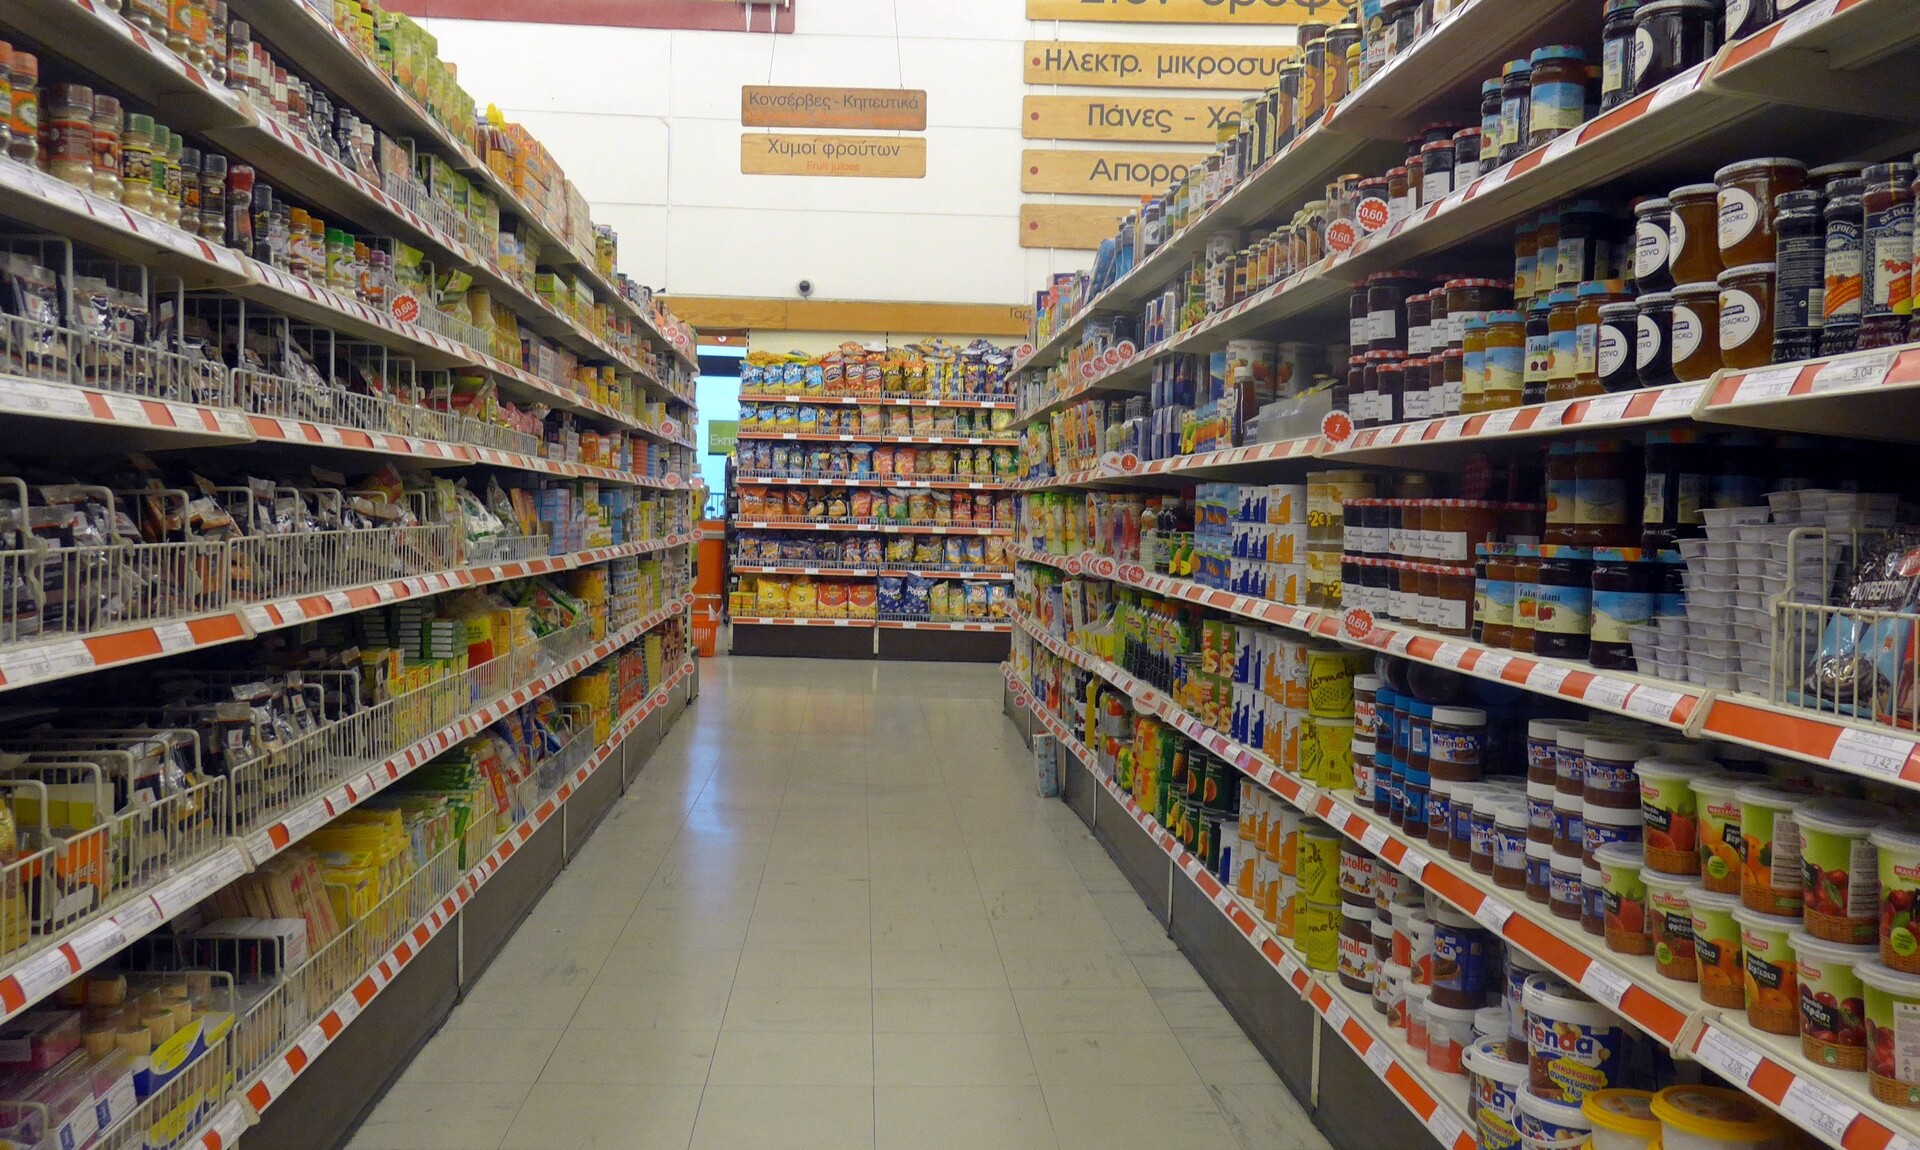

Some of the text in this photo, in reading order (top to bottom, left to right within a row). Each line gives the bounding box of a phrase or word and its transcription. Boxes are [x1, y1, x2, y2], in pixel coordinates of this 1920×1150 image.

[1045, 48, 1142, 77] Ηλεκτρ.
[749, 92, 830, 110] Κονσέρβες
[843, 95, 919, 111] Κηπευτικά
[1088, 103, 1173, 133] Πάνες
[768, 138, 900, 159] Χυμοί φρούτων
[806, 161, 829, 171] Fruit
[1432, 732, 1470, 749] Merenda
[1590, 766, 1631, 782] Merenda
